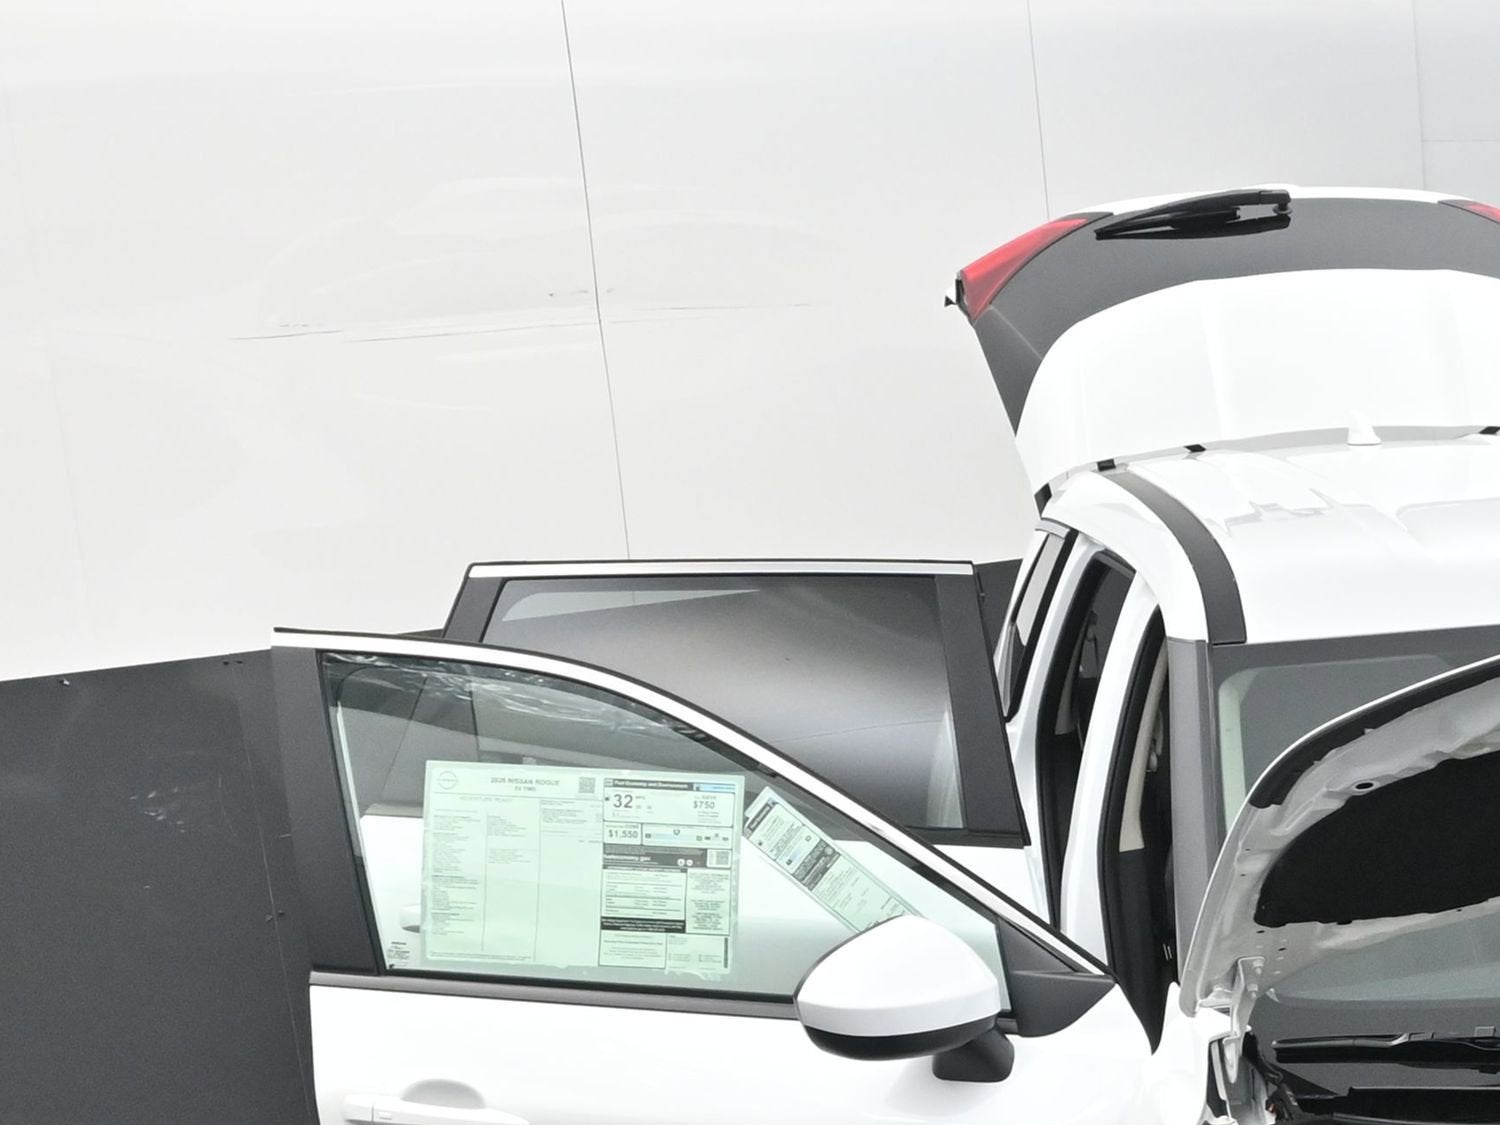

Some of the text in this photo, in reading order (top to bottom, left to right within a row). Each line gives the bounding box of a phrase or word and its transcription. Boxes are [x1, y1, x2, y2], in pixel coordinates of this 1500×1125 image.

[613, 793, 633, 809] 32
[693, 800, 715, 810] $750
[608, 829, 639, 839] $1,550
